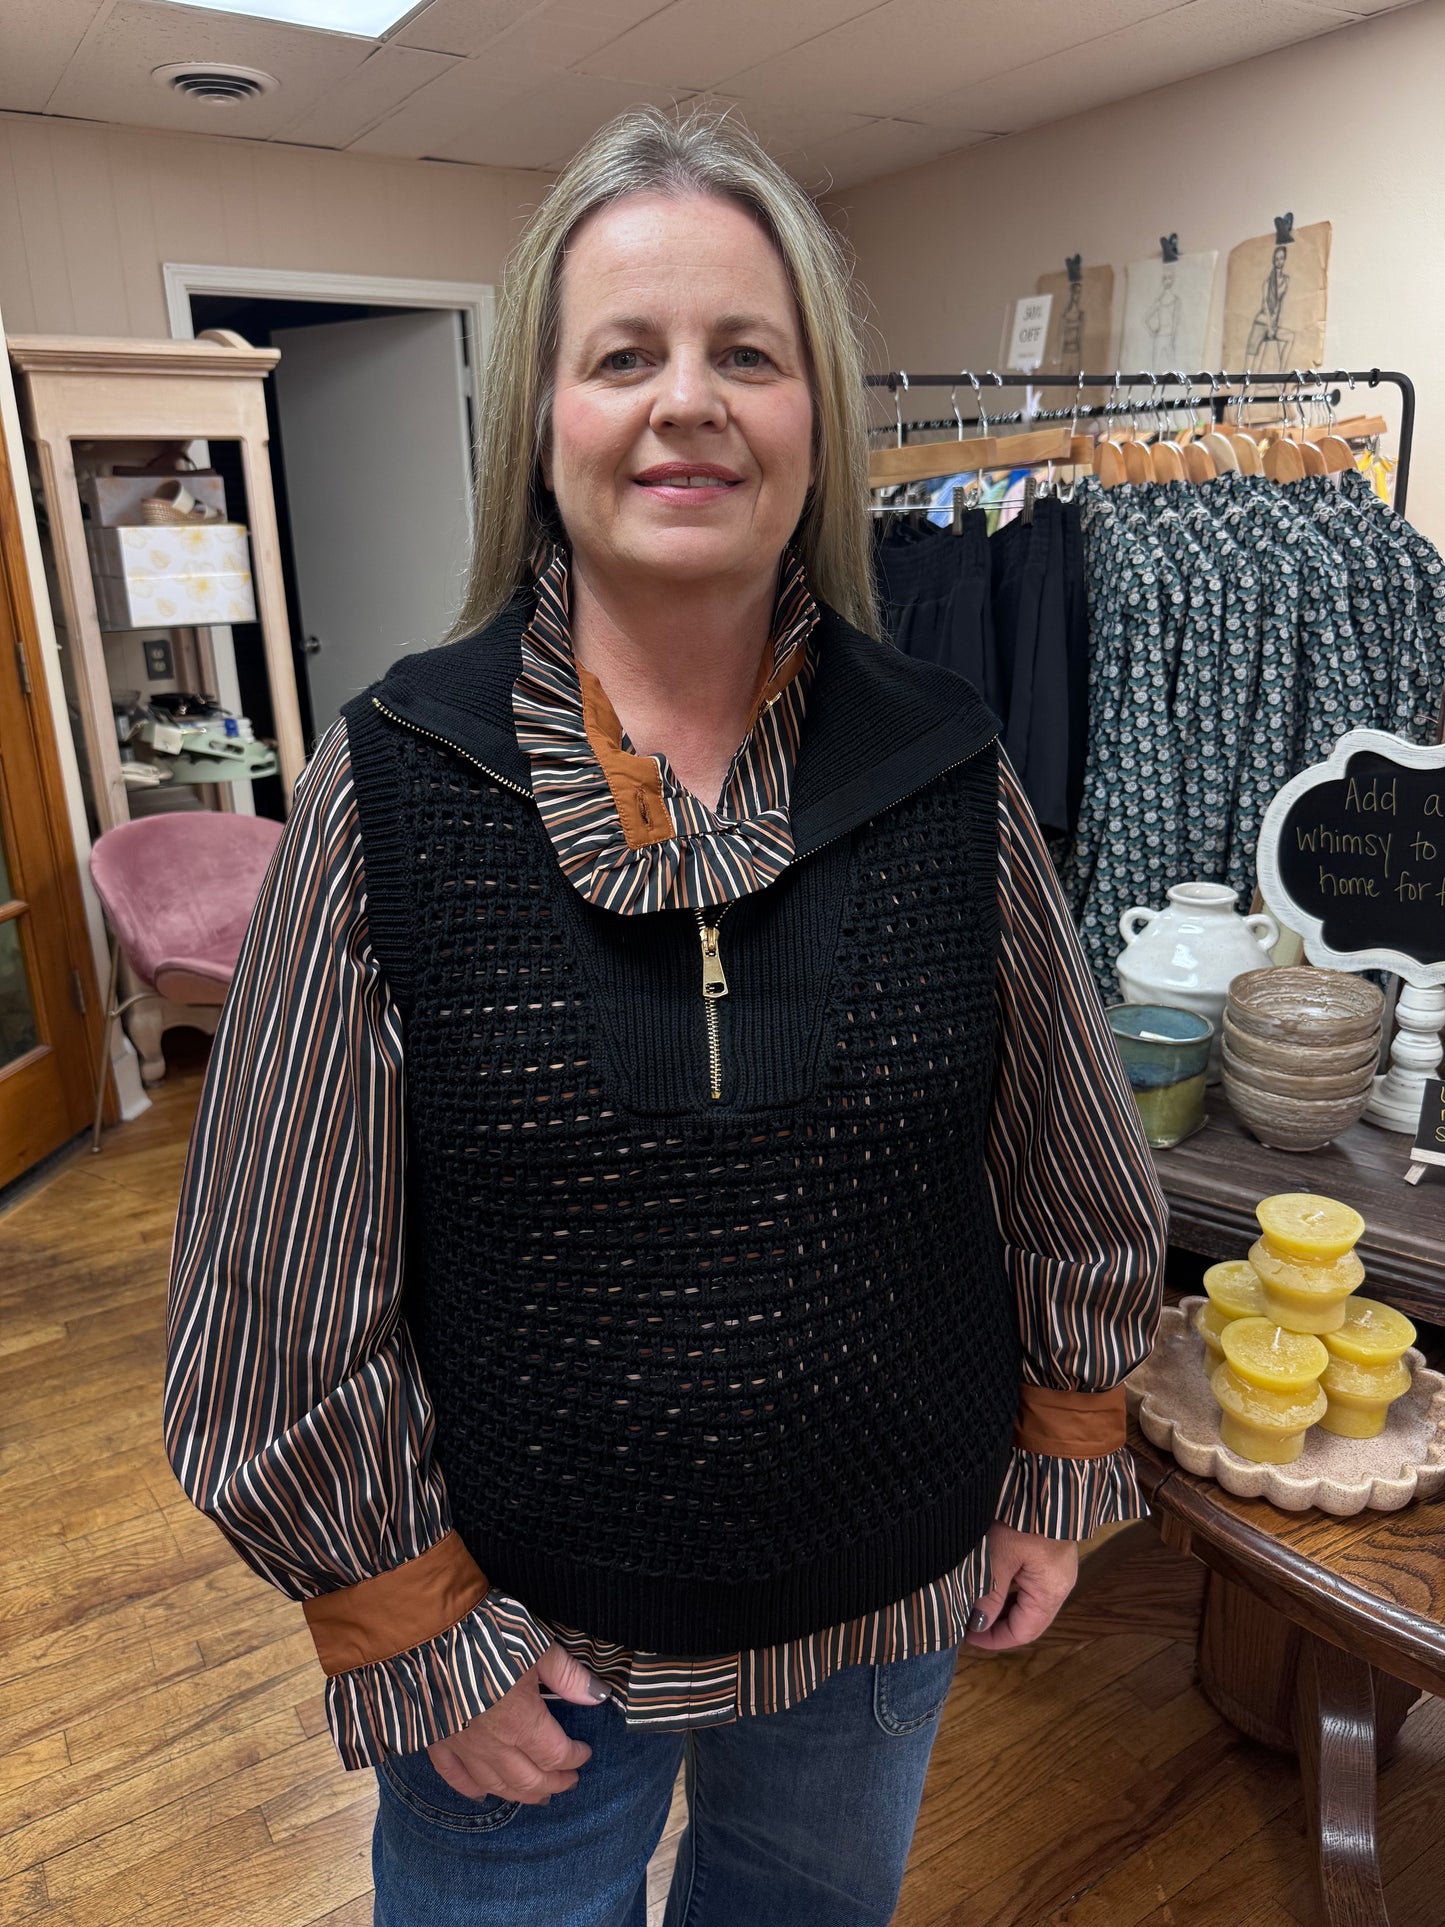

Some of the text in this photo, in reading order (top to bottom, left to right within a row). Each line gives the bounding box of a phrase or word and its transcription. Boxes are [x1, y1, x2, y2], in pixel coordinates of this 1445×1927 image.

[1019, 327, 1042, 343] OFF
[1344, 777, 1444, 817] Add a
[1409, 831, 1437, 861] to
[1319, 865, 1380, 898] home
[1394, 870, 1431, 902] for
